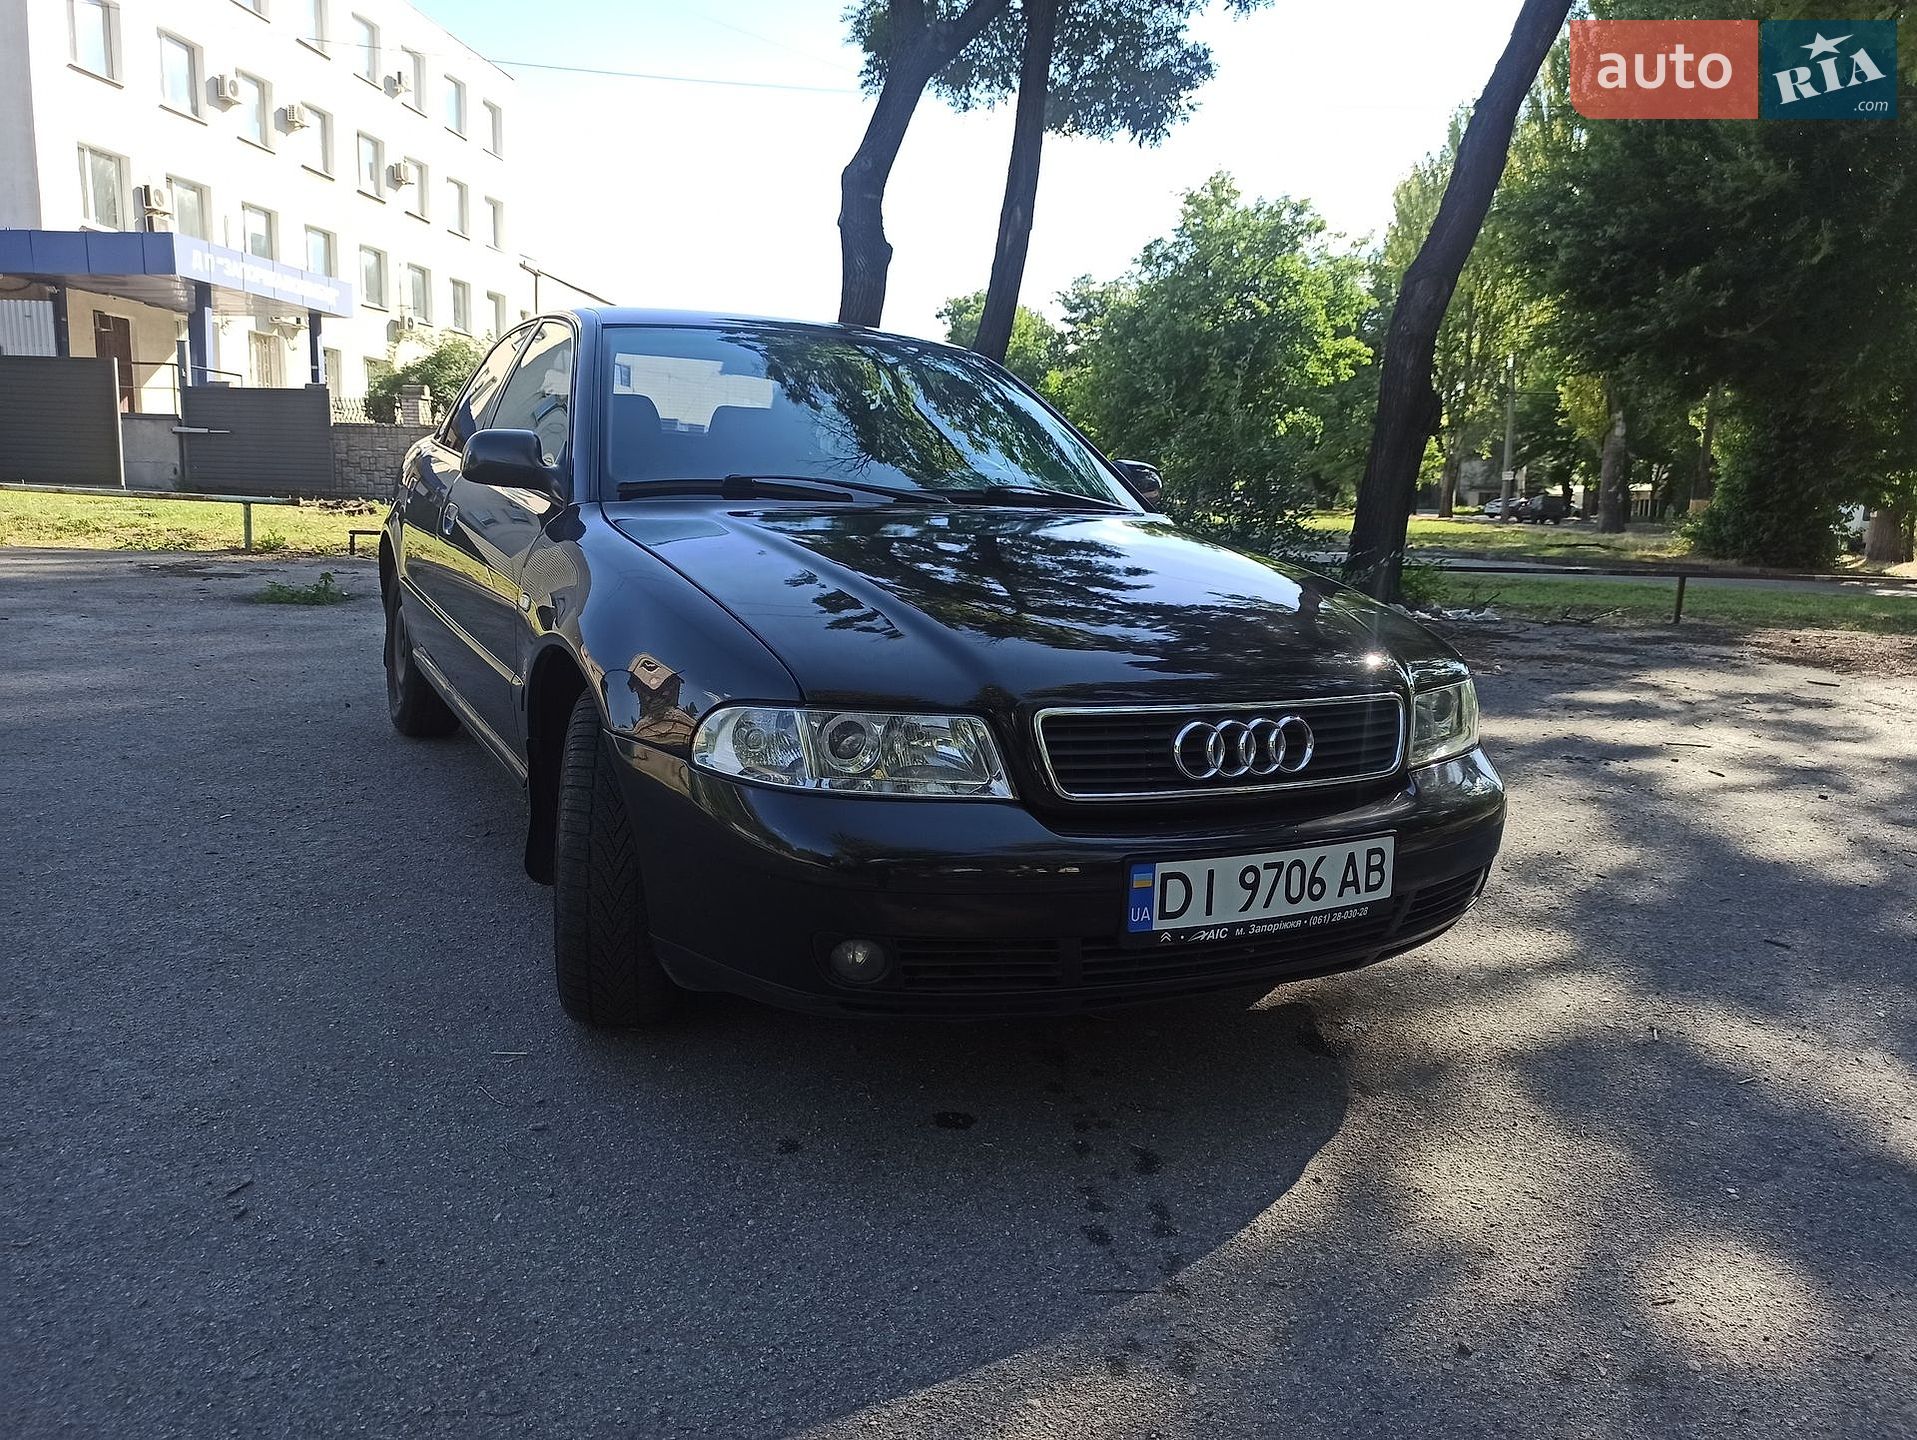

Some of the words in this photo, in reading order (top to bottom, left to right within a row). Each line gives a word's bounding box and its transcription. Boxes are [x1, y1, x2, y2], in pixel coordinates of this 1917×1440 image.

[1158, 869, 1214, 921] DI
[1238, 855, 1327, 912] 9706
[1337, 847, 1386, 898] AB
[1131, 907, 1151, 922] UA
[1309, 913, 1331, 927] (061)
